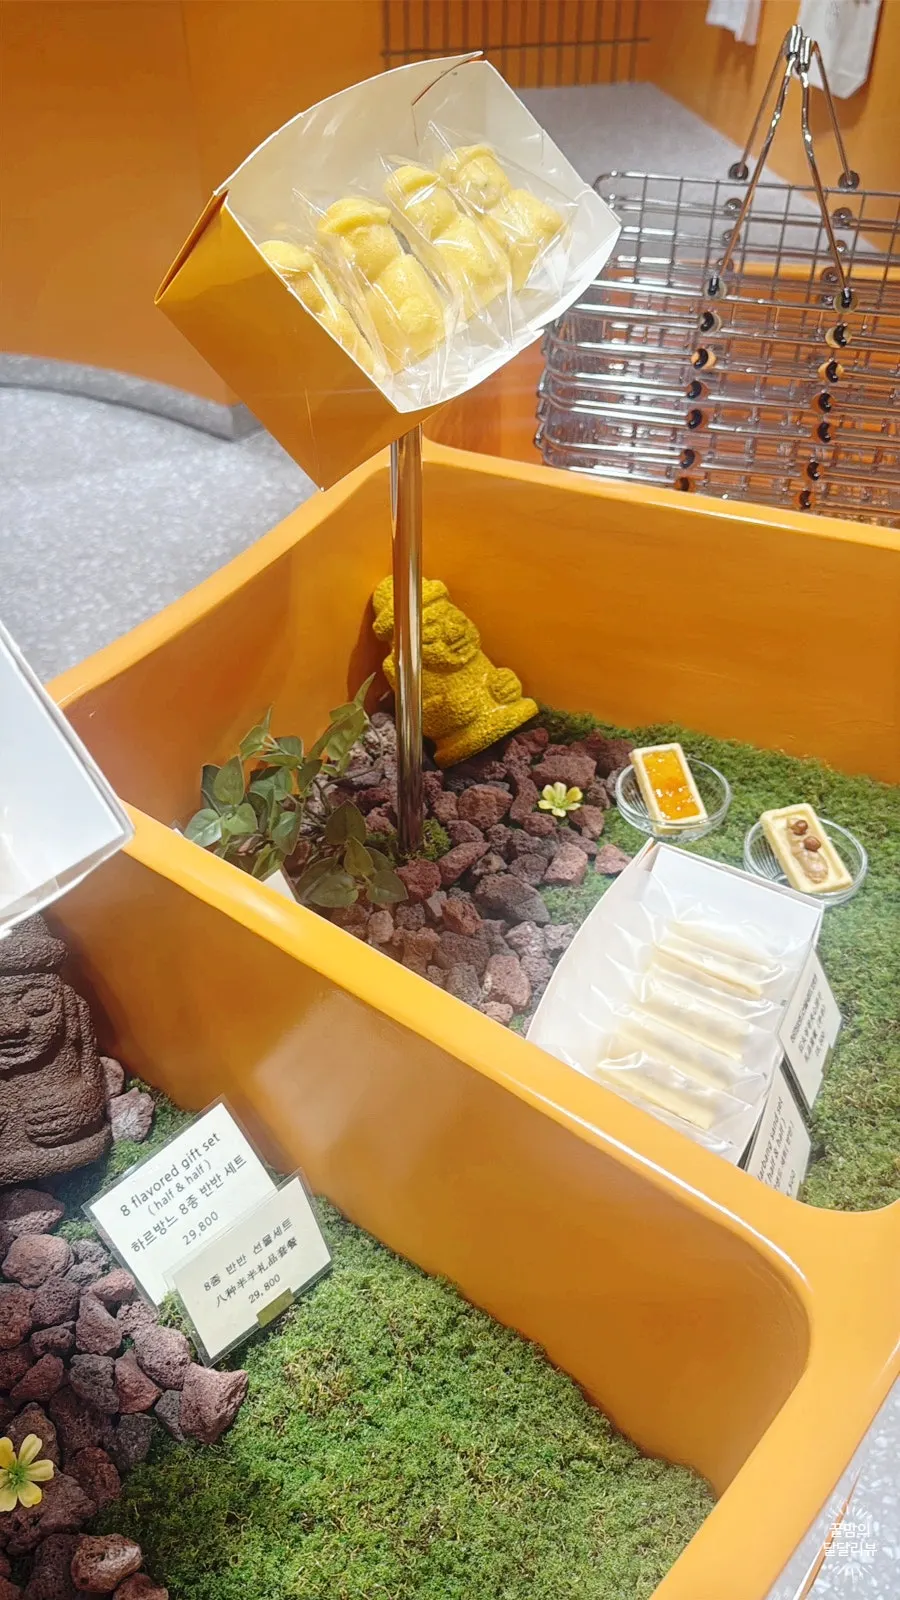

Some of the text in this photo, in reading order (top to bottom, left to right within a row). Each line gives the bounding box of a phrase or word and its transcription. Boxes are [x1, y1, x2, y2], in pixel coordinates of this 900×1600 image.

[120, 1132, 221, 1217] 8 flavored gift set
[131, 1154, 248, 1252] 하르방느 8종 반반 세트
[175, 1182, 185, 1193] &
[182, 1210, 219, 1246] 29,800
[203, 1217, 293, 1292] 8종 반반 선물세트
